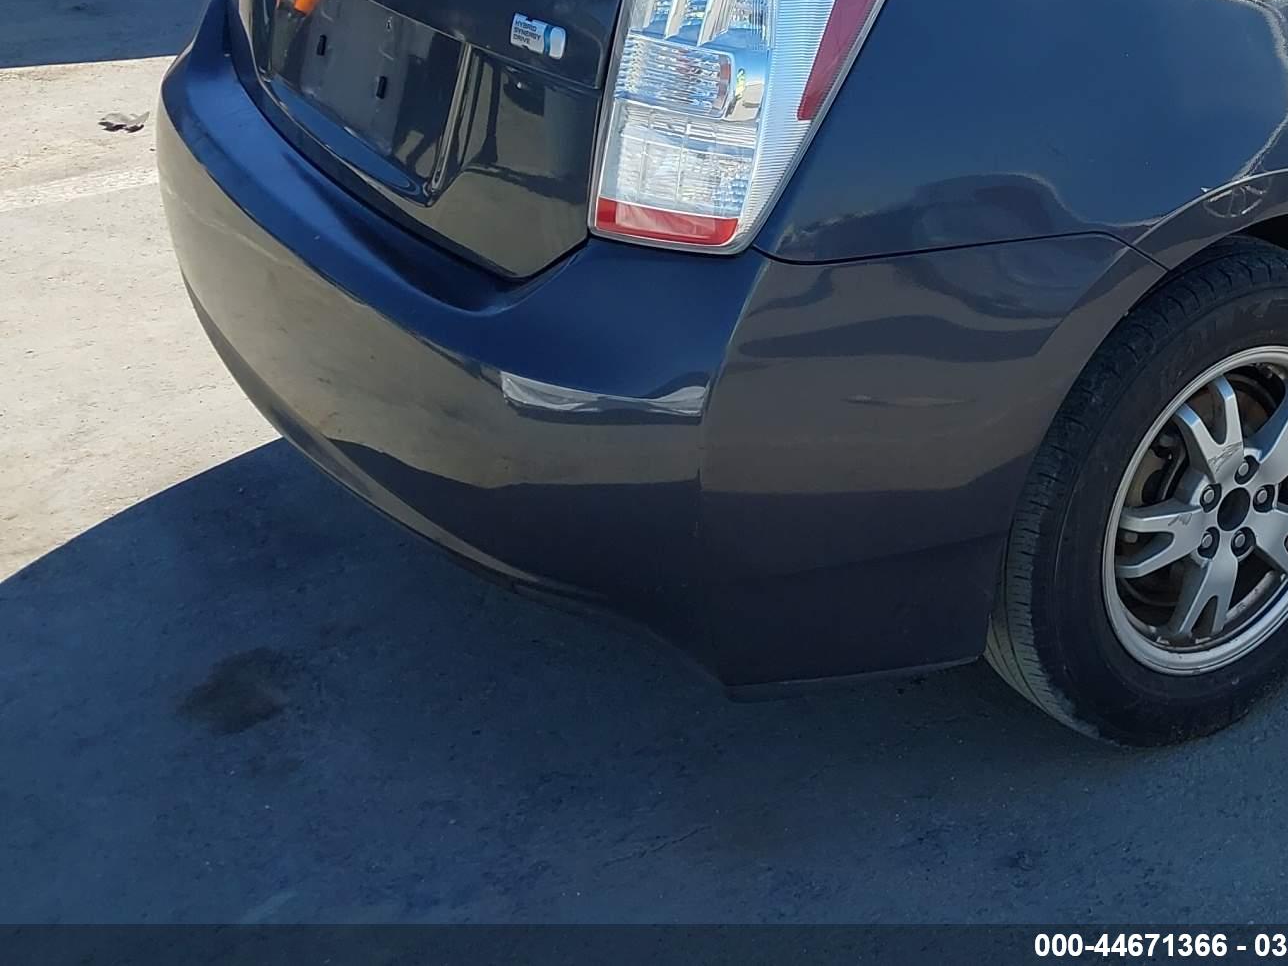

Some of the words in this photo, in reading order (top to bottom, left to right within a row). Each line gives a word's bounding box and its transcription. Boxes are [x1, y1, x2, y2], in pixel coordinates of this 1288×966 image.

[515, 20, 538, 32] HYBRID
[512, 27, 541, 41] SYNERGY
[512, 34, 531, 44] DRIVE
